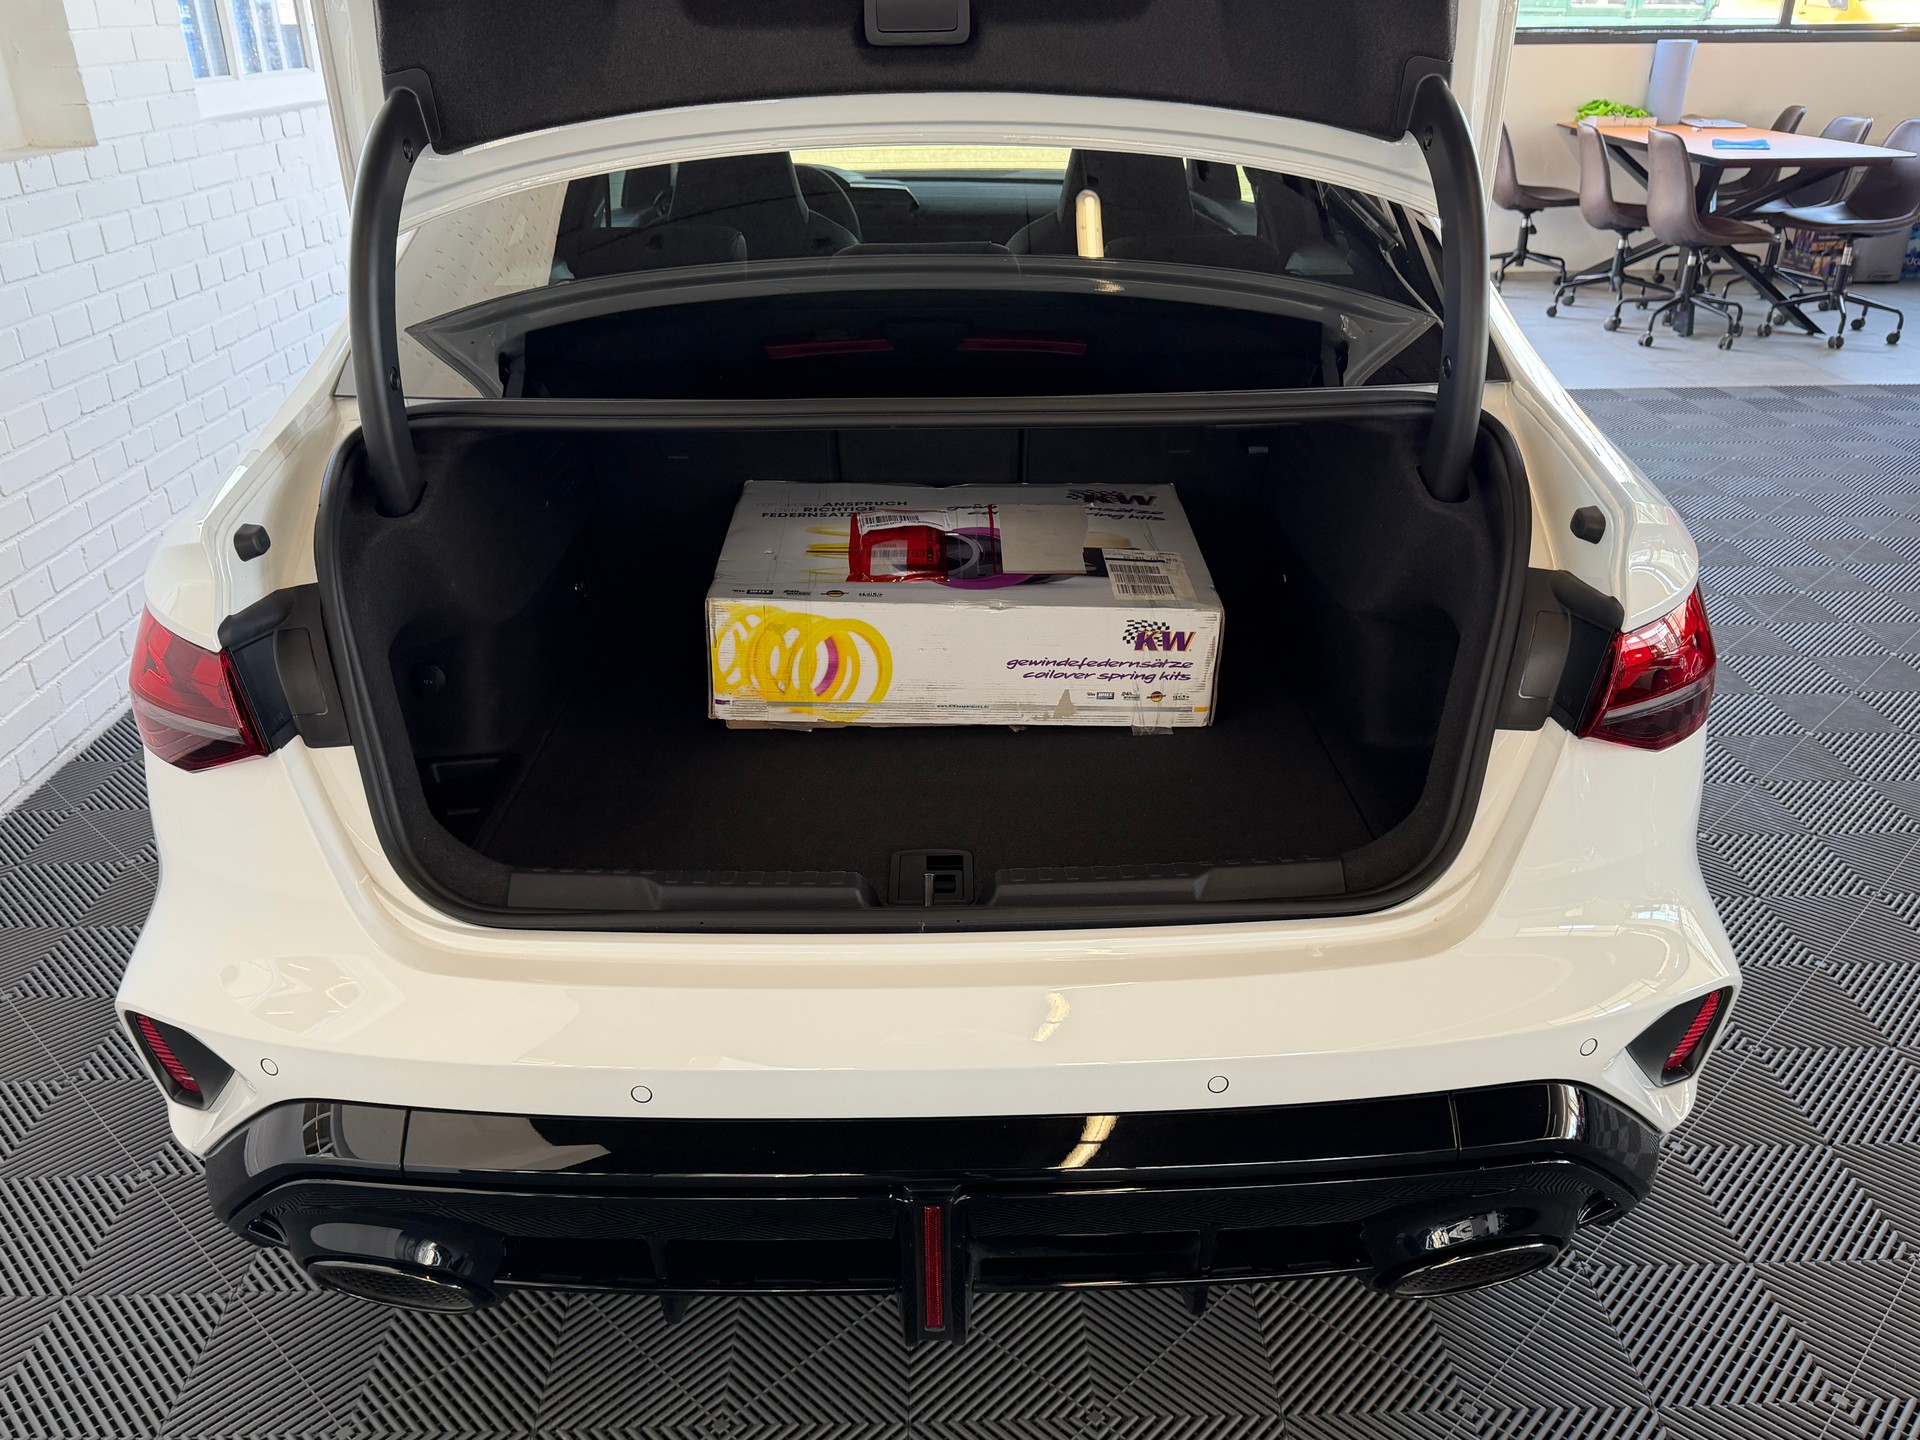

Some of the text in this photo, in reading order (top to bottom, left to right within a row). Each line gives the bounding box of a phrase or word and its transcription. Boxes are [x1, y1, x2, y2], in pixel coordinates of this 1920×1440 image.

[1133, 629, 1197, 652] KW
[1006, 656, 1194, 669] gewindefedernsätze
[1022, 669, 1192, 684] coilover spring kits
